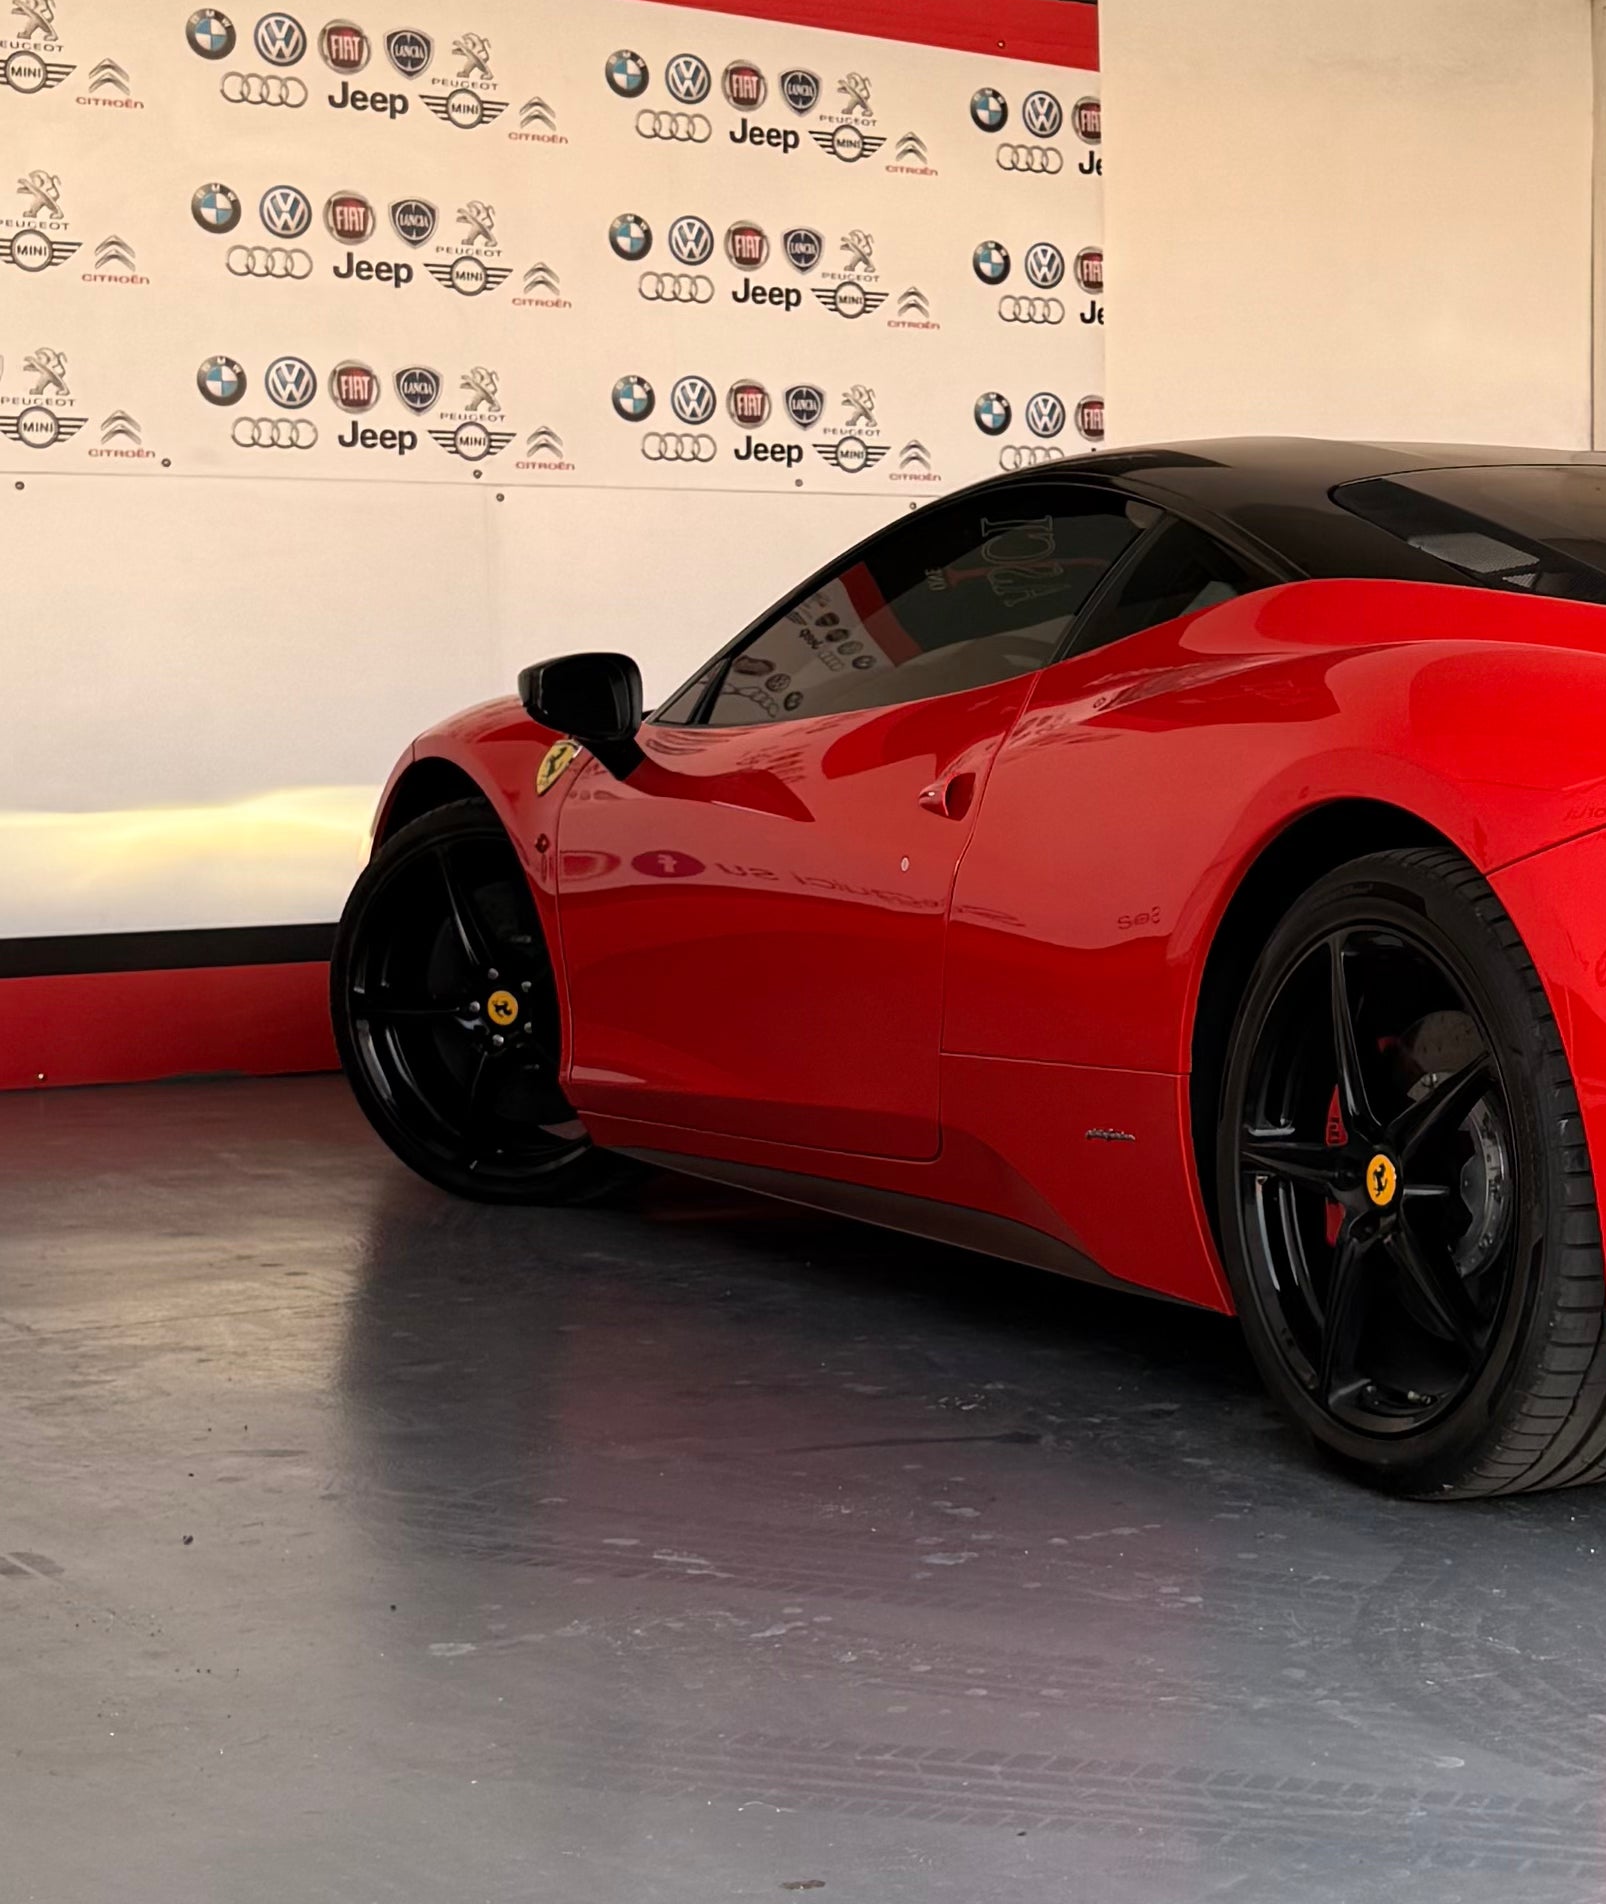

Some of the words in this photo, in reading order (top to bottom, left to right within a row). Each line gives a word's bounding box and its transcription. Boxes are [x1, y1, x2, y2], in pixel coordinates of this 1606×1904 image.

[330, 36, 361, 61] FIAT
[11, 66, 41, 79] MINI
[431, 77, 499, 91] PEUGEOT
[732, 74, 758, 99] FIAT
[328, 81, 409, 119] Jeep
[451, 103, 479, 115] MINI
[819, 114, 878, 127] PEUGEOT
[729, 118, 800, 154] Jeep
[836, 138, 861, 149] MINI
[335, 206, 366, 232] FIAT
[17, 245, 47, 257] MINI
[436, 246, 503, 257] PEUGEOT
[734, 235, 762, 259] FIAT
[333, 251, 413, 288] Jeep
[455, 270, 482, 282] MINI
[821, 271, 880, 283] PEUGEOT
[731, 277, 802, 312] Jeep
[838, 295, 863, 306] MINI
[341, 375, 370, 400] FIAT
[0, 397, 77, 408] PEUGEOT
[736, 393, 763, 417] FIAT
[440, 412, 506, 423] PEUGEOT
[23, 422, 54, 434] MINI
[823, 427, 881, 437] PEUGEOT
[338, 420, 418, 455] Jeep
[459, 435, 486, 448] MINI
[734, 435, 803, 469] Jeep
[840, 448, 864, 460] MINI
